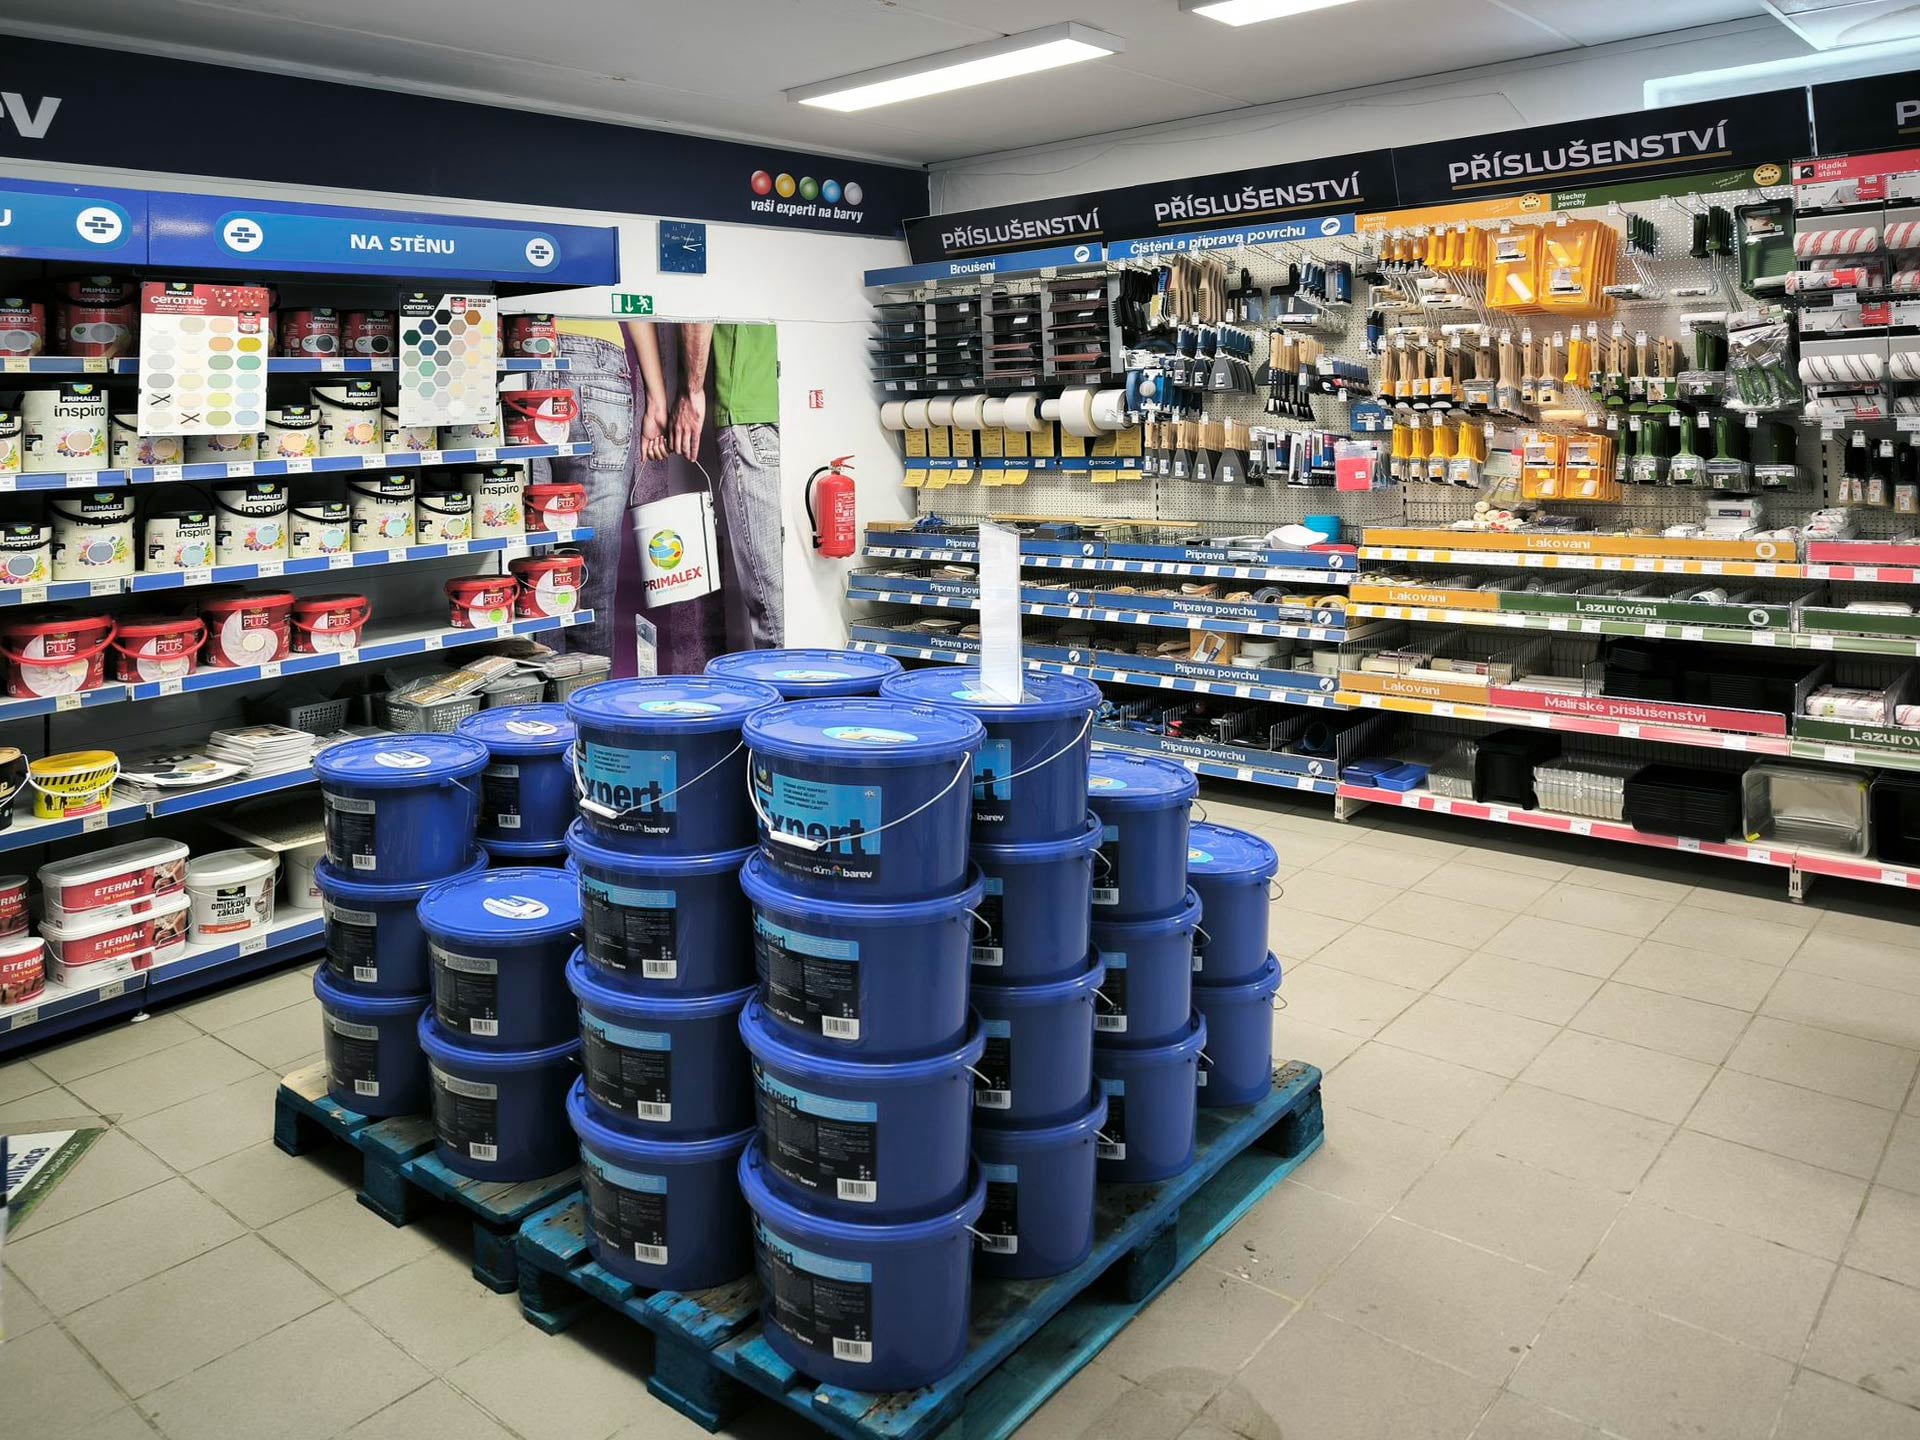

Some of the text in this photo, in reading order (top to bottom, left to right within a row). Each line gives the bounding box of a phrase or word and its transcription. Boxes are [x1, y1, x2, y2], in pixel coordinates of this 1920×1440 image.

[1448, 119, 1728, 184] PŘÍSLUŠENSTVÍ
[1153, 170, 1361, 223] PŘÍSLUŠENSTVÍ
[751, 199, 864, 224] vaši experti na barvy
[941, 207, 1100, 249] PŘÍSLUŠENSTVÍ
[1177, 240, 1186, 250] a
[1247, 226, 1306, 244] povrchu
[350, 232, 455, 257] NA STĚNU
[150, 295, 208, 305] ceramic
[53, 405, 106, 420] inspiro
[484, 475, 515, 483] PRIMALEX
[479, 484, 520, 497] inspiro
[83, 503, 123, 512] PRIMALEX
[5, 533, 41, 542] PRIMALEX
[175, 528, 212, 539] inspiro
[554, 575, 573, 585] PLUS
[642, 566, 703, 592] PRIMALEX
[484, 594, 504, 604] PLUS
[1215, 605, 1257, 617] povrchu
[243, 617, 270, 628] PLUS
[328, 617, 352, 627] PLUS
[46, 642, 76, 654] PLUS
[157, 641, 184, 652] PLUS
[1217, 668, 1260, 681] povrchu
[1203, 747, 1246, 762] povrchu
[976, 812, 1005, 823] barev
[643, 825, 671, 835] barev
[842, 867, 873, 879] barev
[94, 878, 145, 897] ETERNAL
[0, 892, 27, 906] RNAL
[216, 906, 245, 918] základ
[95, 930, 145, 951] ETERNAL
